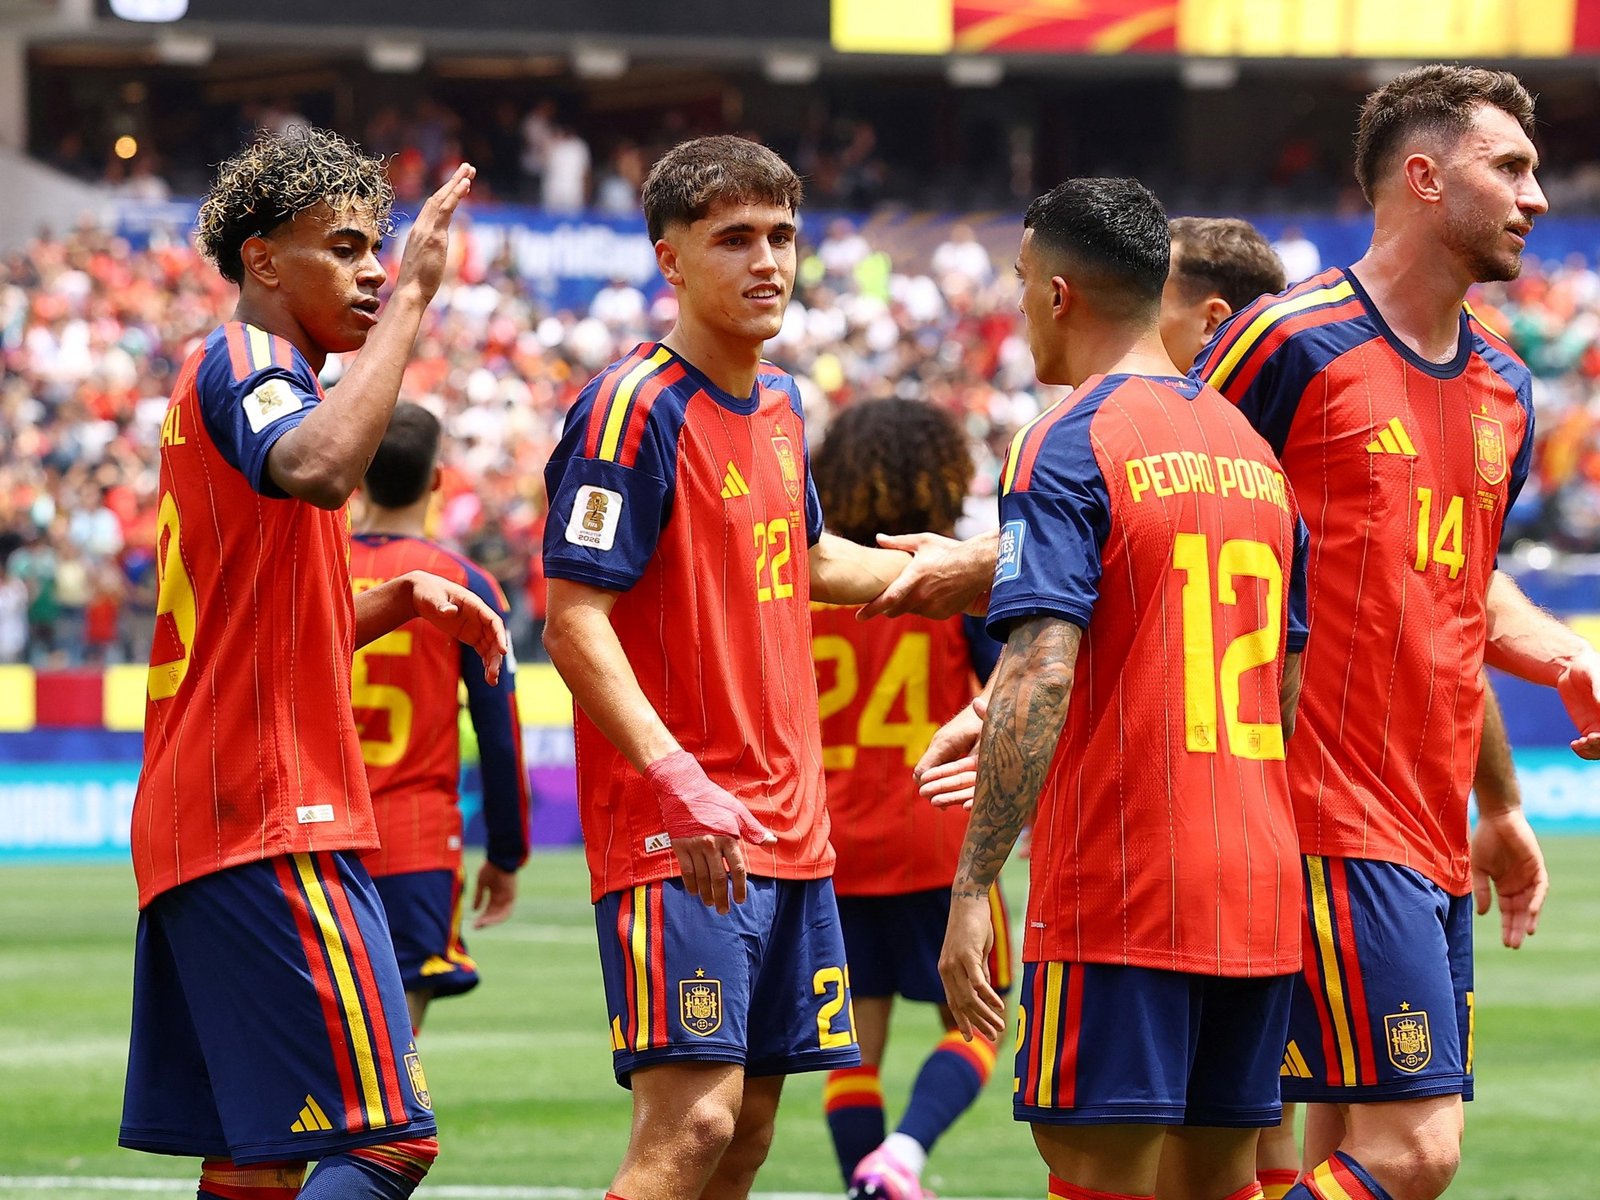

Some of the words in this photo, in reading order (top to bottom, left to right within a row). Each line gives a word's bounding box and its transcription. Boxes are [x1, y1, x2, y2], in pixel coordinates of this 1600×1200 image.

[160, 404, 186, 448] AL
[1125, 451, 1215, 503] PEDRO
[1214, 456, 1288, 512] PORRO
[578, 535, 600, 543] 2026
[754, 518, 793, 602] 22
[1414, 487, 1465, 579] 14
[1173, 532, 1286, 761] 12
[351, 630, 414, 768] 5
[812, 631, 939, 770] 24
[812, 963, 857, 1050] 2
